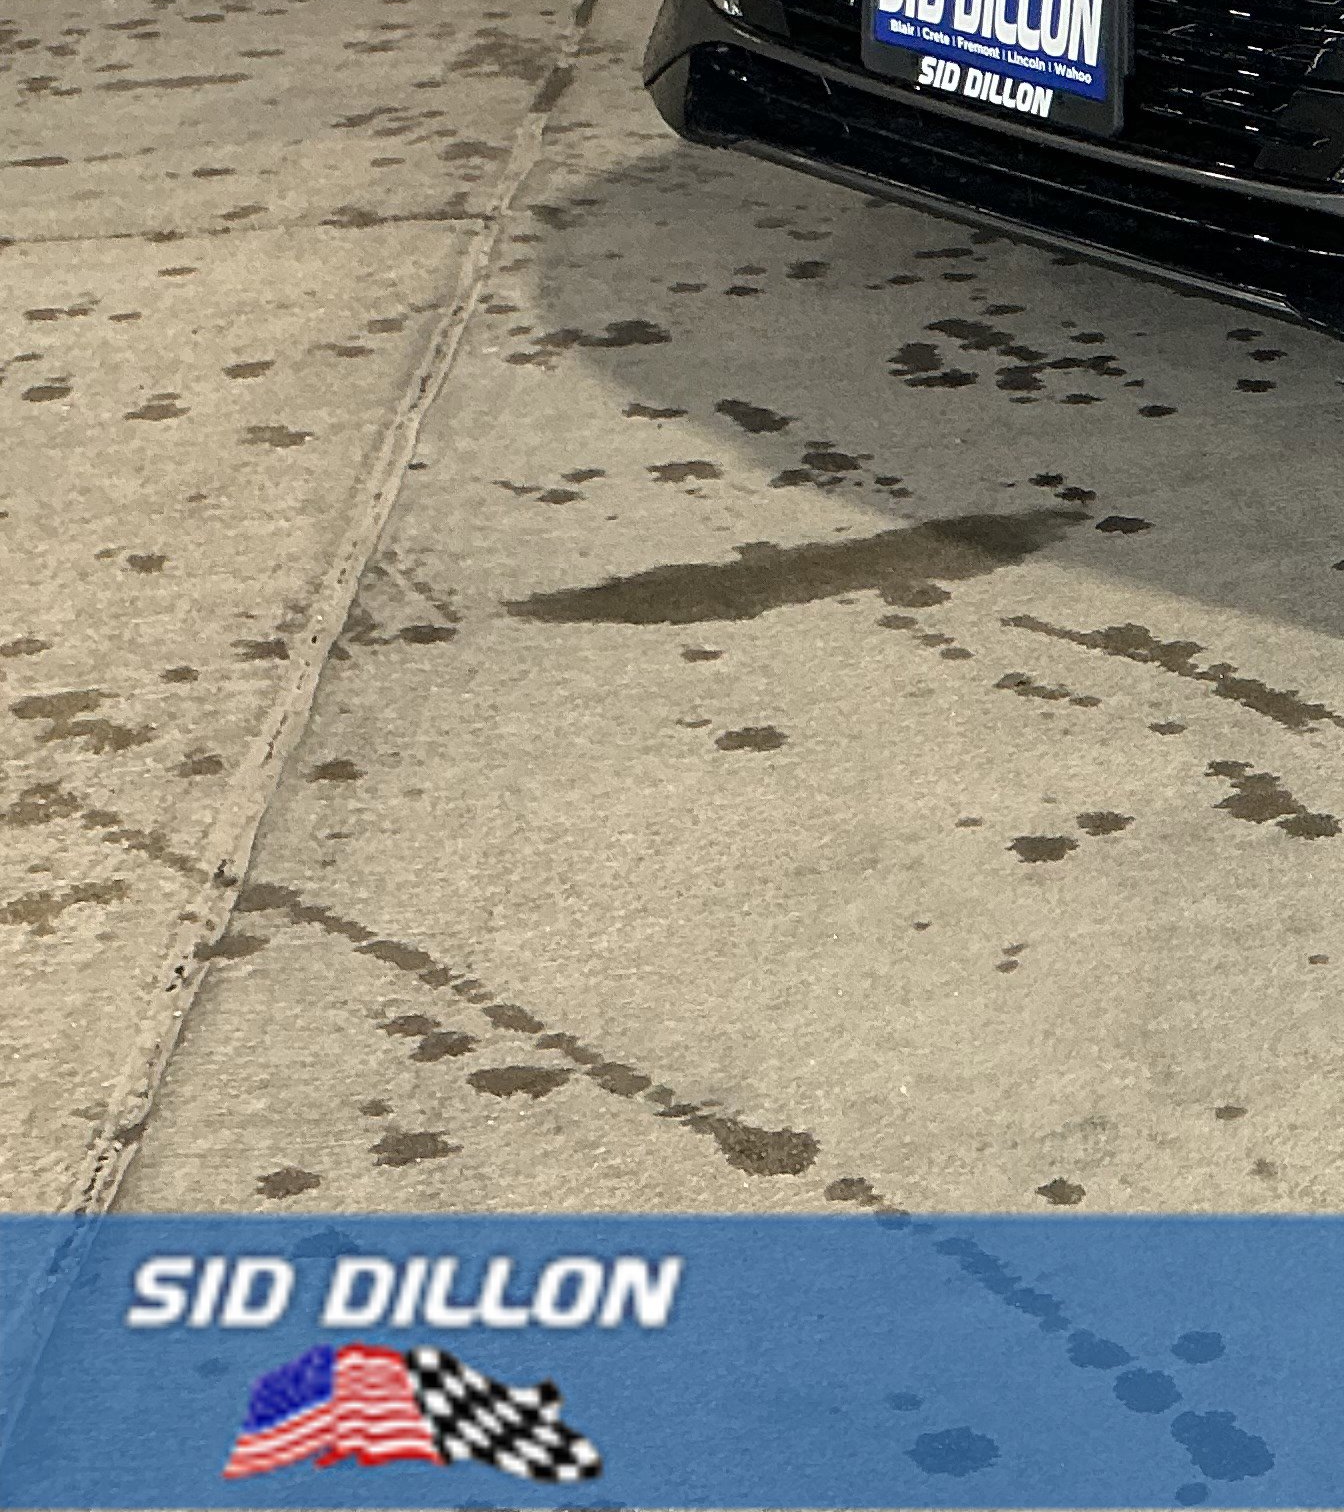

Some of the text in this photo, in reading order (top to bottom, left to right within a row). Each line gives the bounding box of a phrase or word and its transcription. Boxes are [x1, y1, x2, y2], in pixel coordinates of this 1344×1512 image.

[921, 27, 951, 46] Crete
[957, 37, 1001, 60] Fremont
[1007, 50, 1047, 72] Lincoln
[1053, 61, 1093, 85] Wahoo
[917, 55, 1054, 118] SID DILLON
